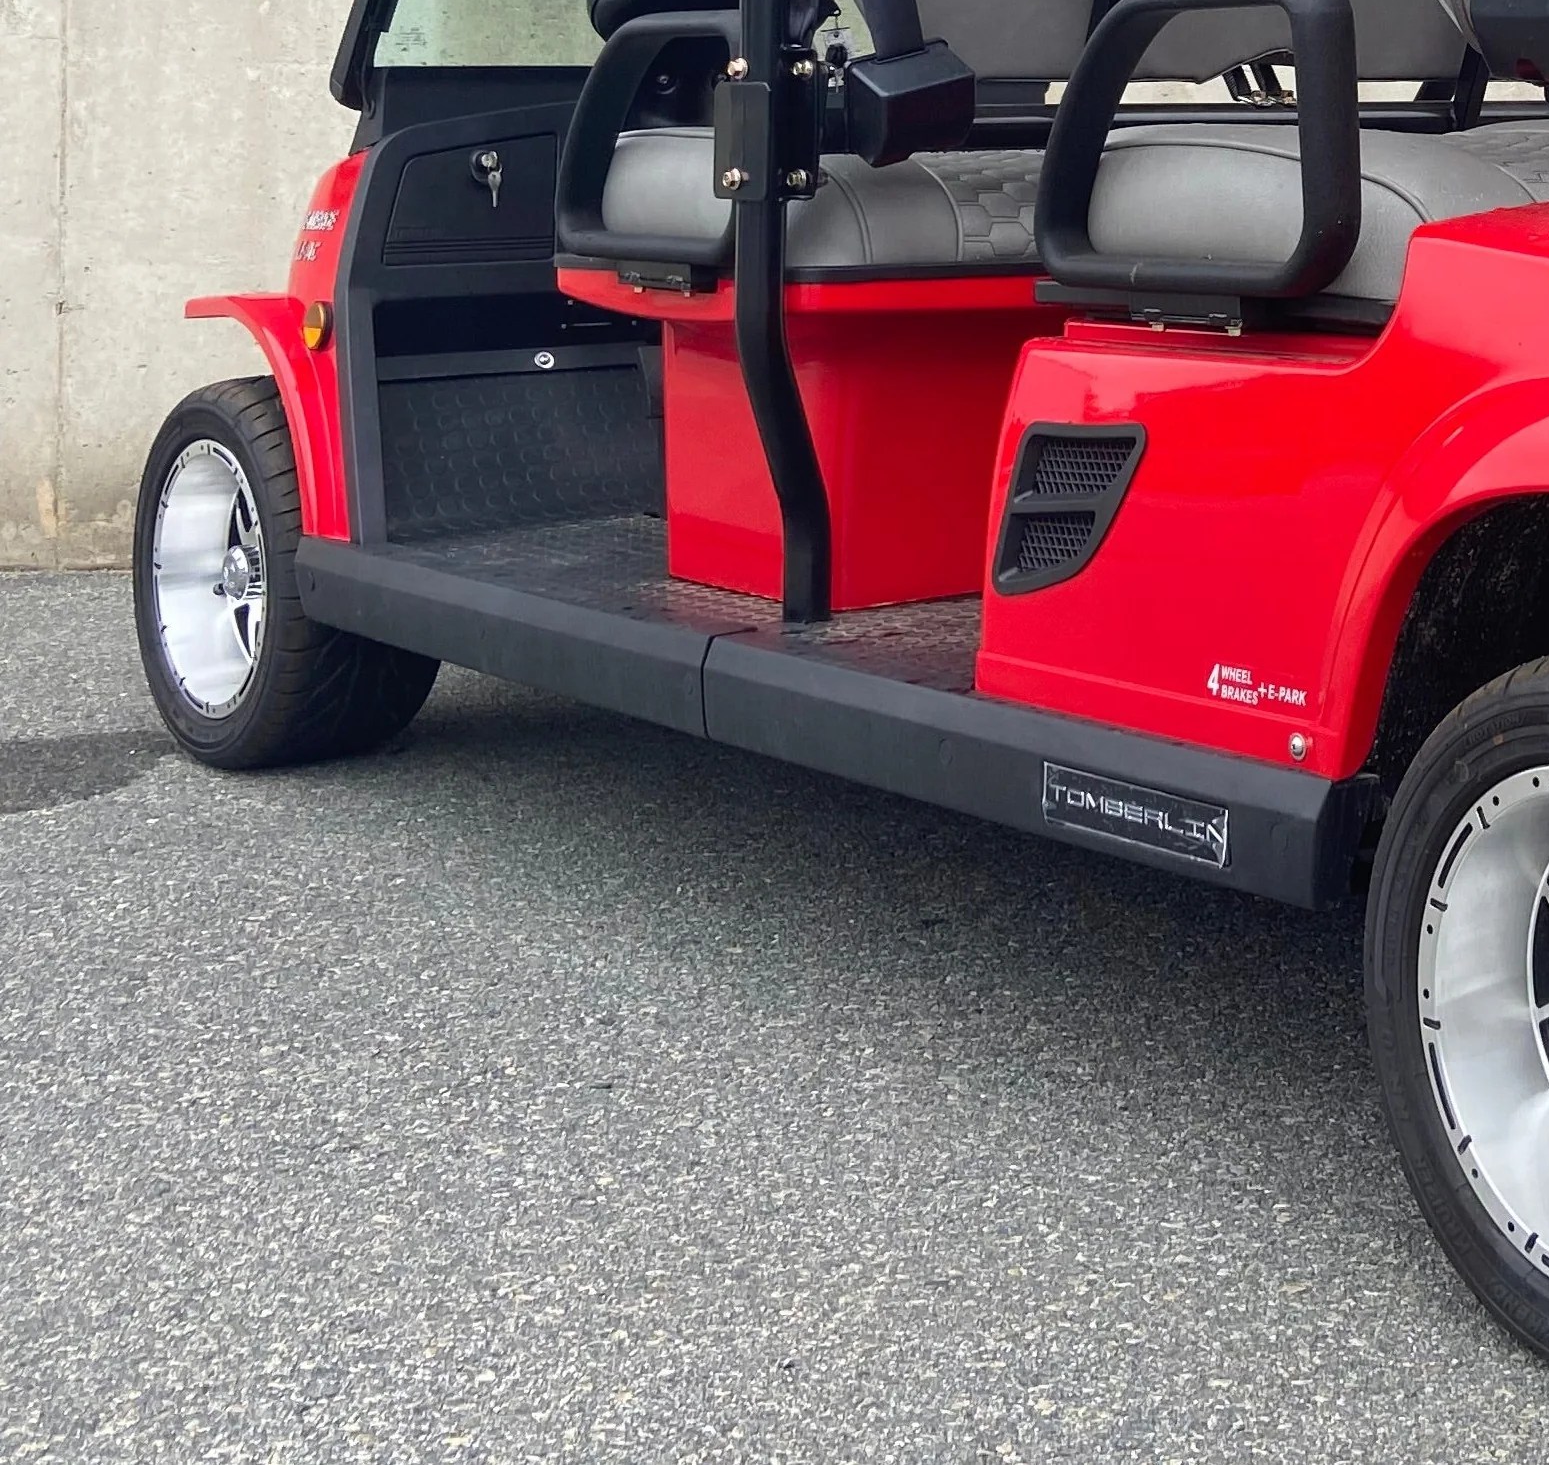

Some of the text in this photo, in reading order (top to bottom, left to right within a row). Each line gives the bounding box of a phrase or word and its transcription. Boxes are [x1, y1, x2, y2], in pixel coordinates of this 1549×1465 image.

[1206, 663, 1220, 696] 4
[1221, 665, 1253, 685] WHEEL
[1221, 684, 1259, 705] BRAKES
[1050, 783, 1224, 844] TOMBERLIN
